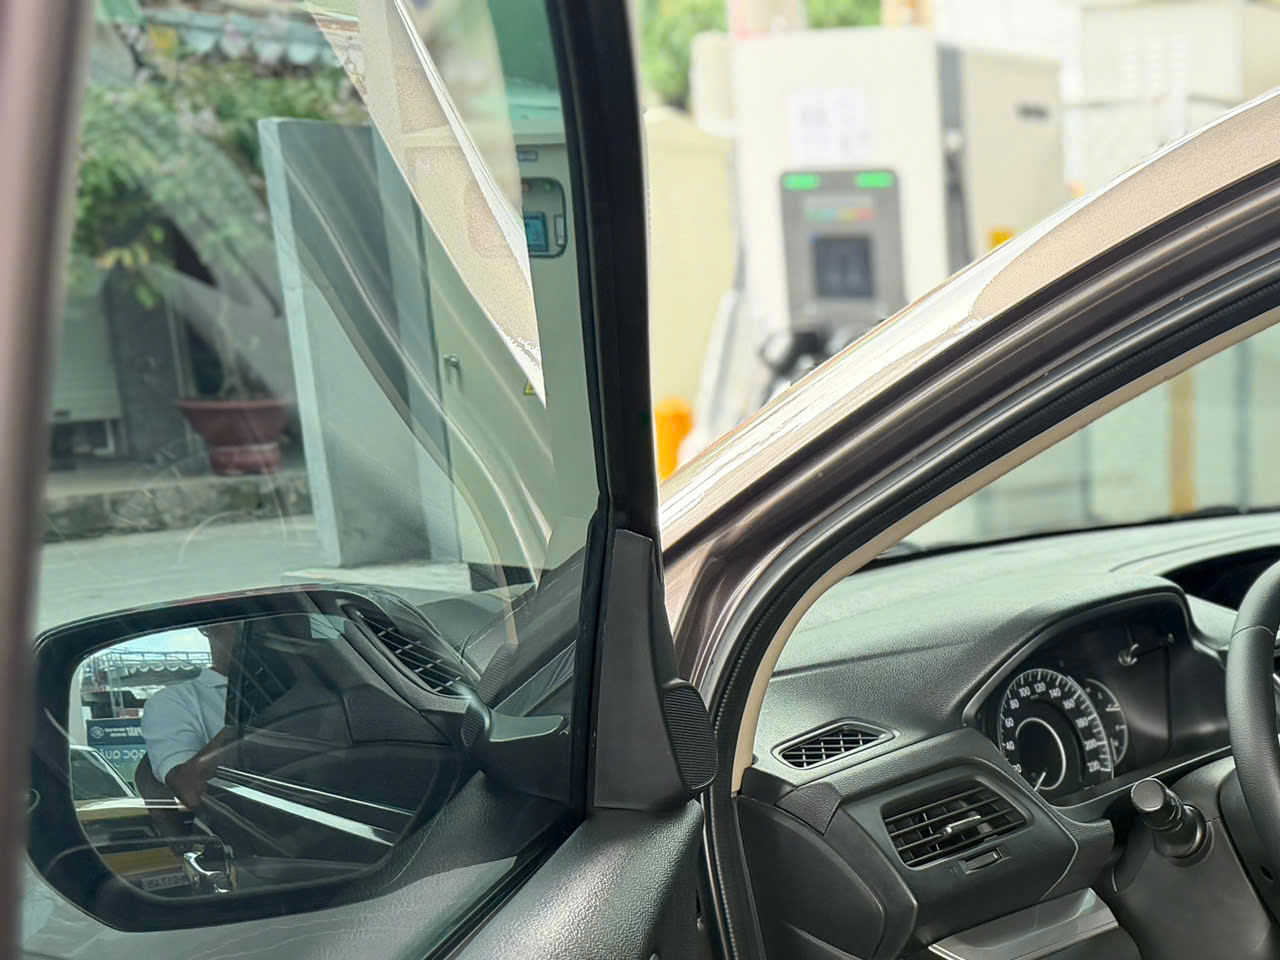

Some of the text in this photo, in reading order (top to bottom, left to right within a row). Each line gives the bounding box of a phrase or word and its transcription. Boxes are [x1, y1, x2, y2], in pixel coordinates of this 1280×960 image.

[1019, 687, 1031, 697] 100
[1034, 682, 1046, 692] 120
[1049, 688, 1061, 698] 140
[1010, 699, 1019, 709] 80
[1063, 699, 1076, 709] 160
[1005, 717, 1014, 727] 60
[1076, 717, 1088, 728] 180
[1006, 740, 1015, 750] 40
[1085, 739, 1097, 750] 200
[1087, 760, 1100, 773] 220
